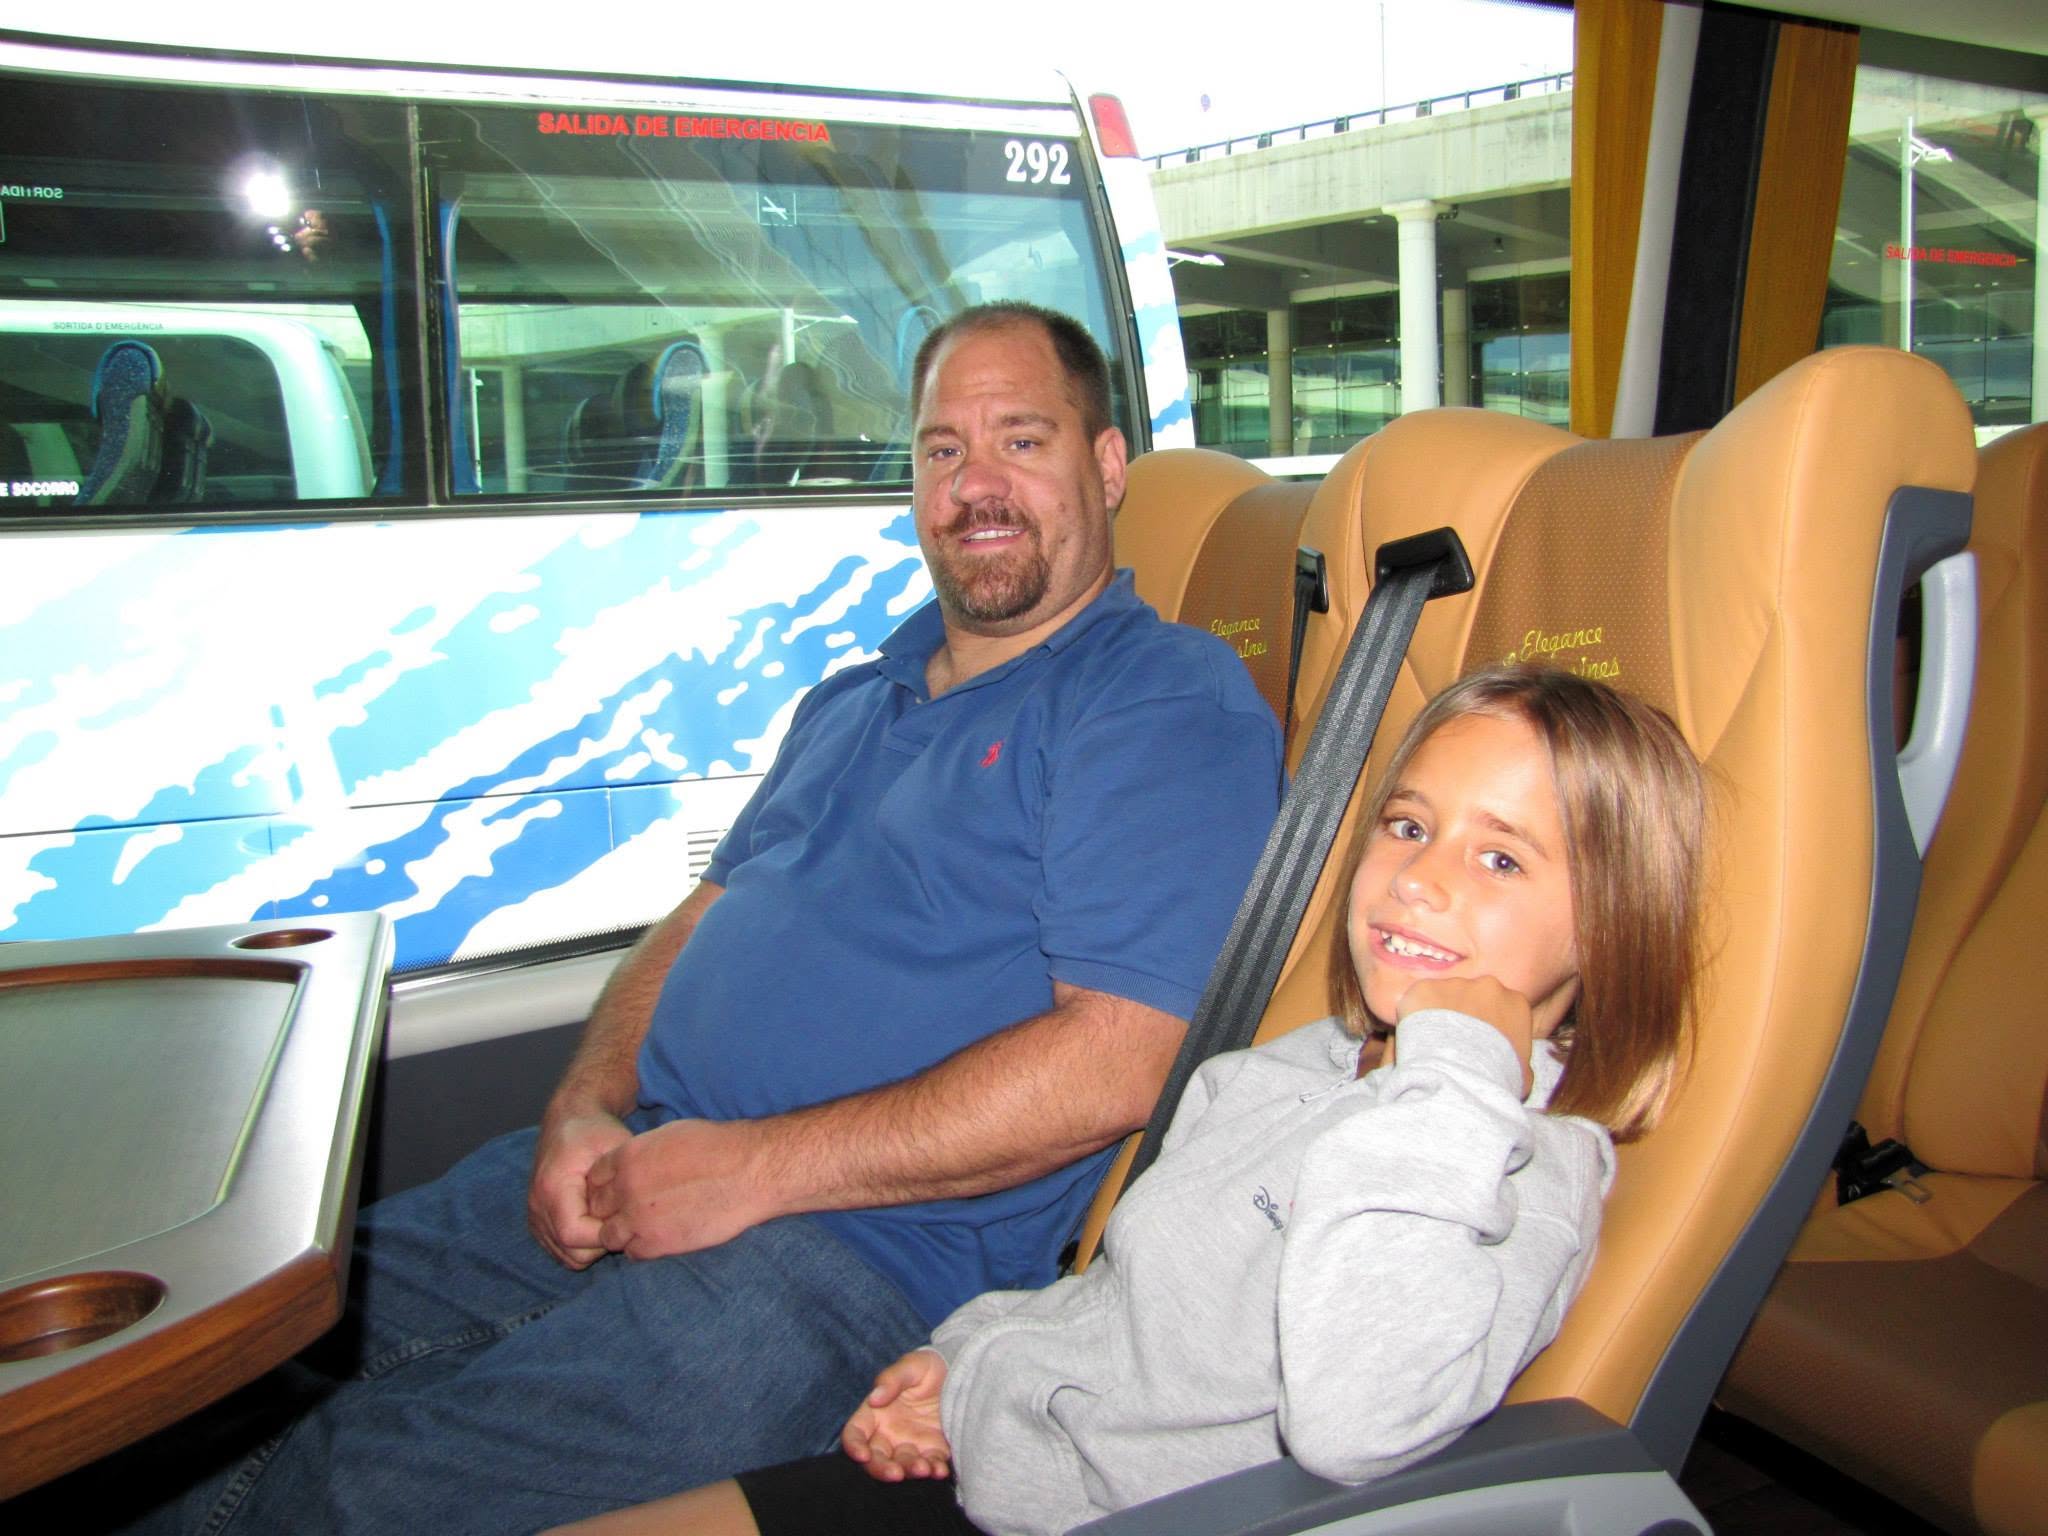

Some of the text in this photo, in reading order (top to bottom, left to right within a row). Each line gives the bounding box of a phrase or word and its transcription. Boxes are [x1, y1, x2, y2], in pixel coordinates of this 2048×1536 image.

[537, 112, 830, 143] SALIDA DE EMERGENCIA
[1004, 139, 1071, 185] 292
[1929, 248, 1945, 263] DE
[11, 480, 80, 497] SOCORRO
[1519, 627, 1602, 662] Elegance
